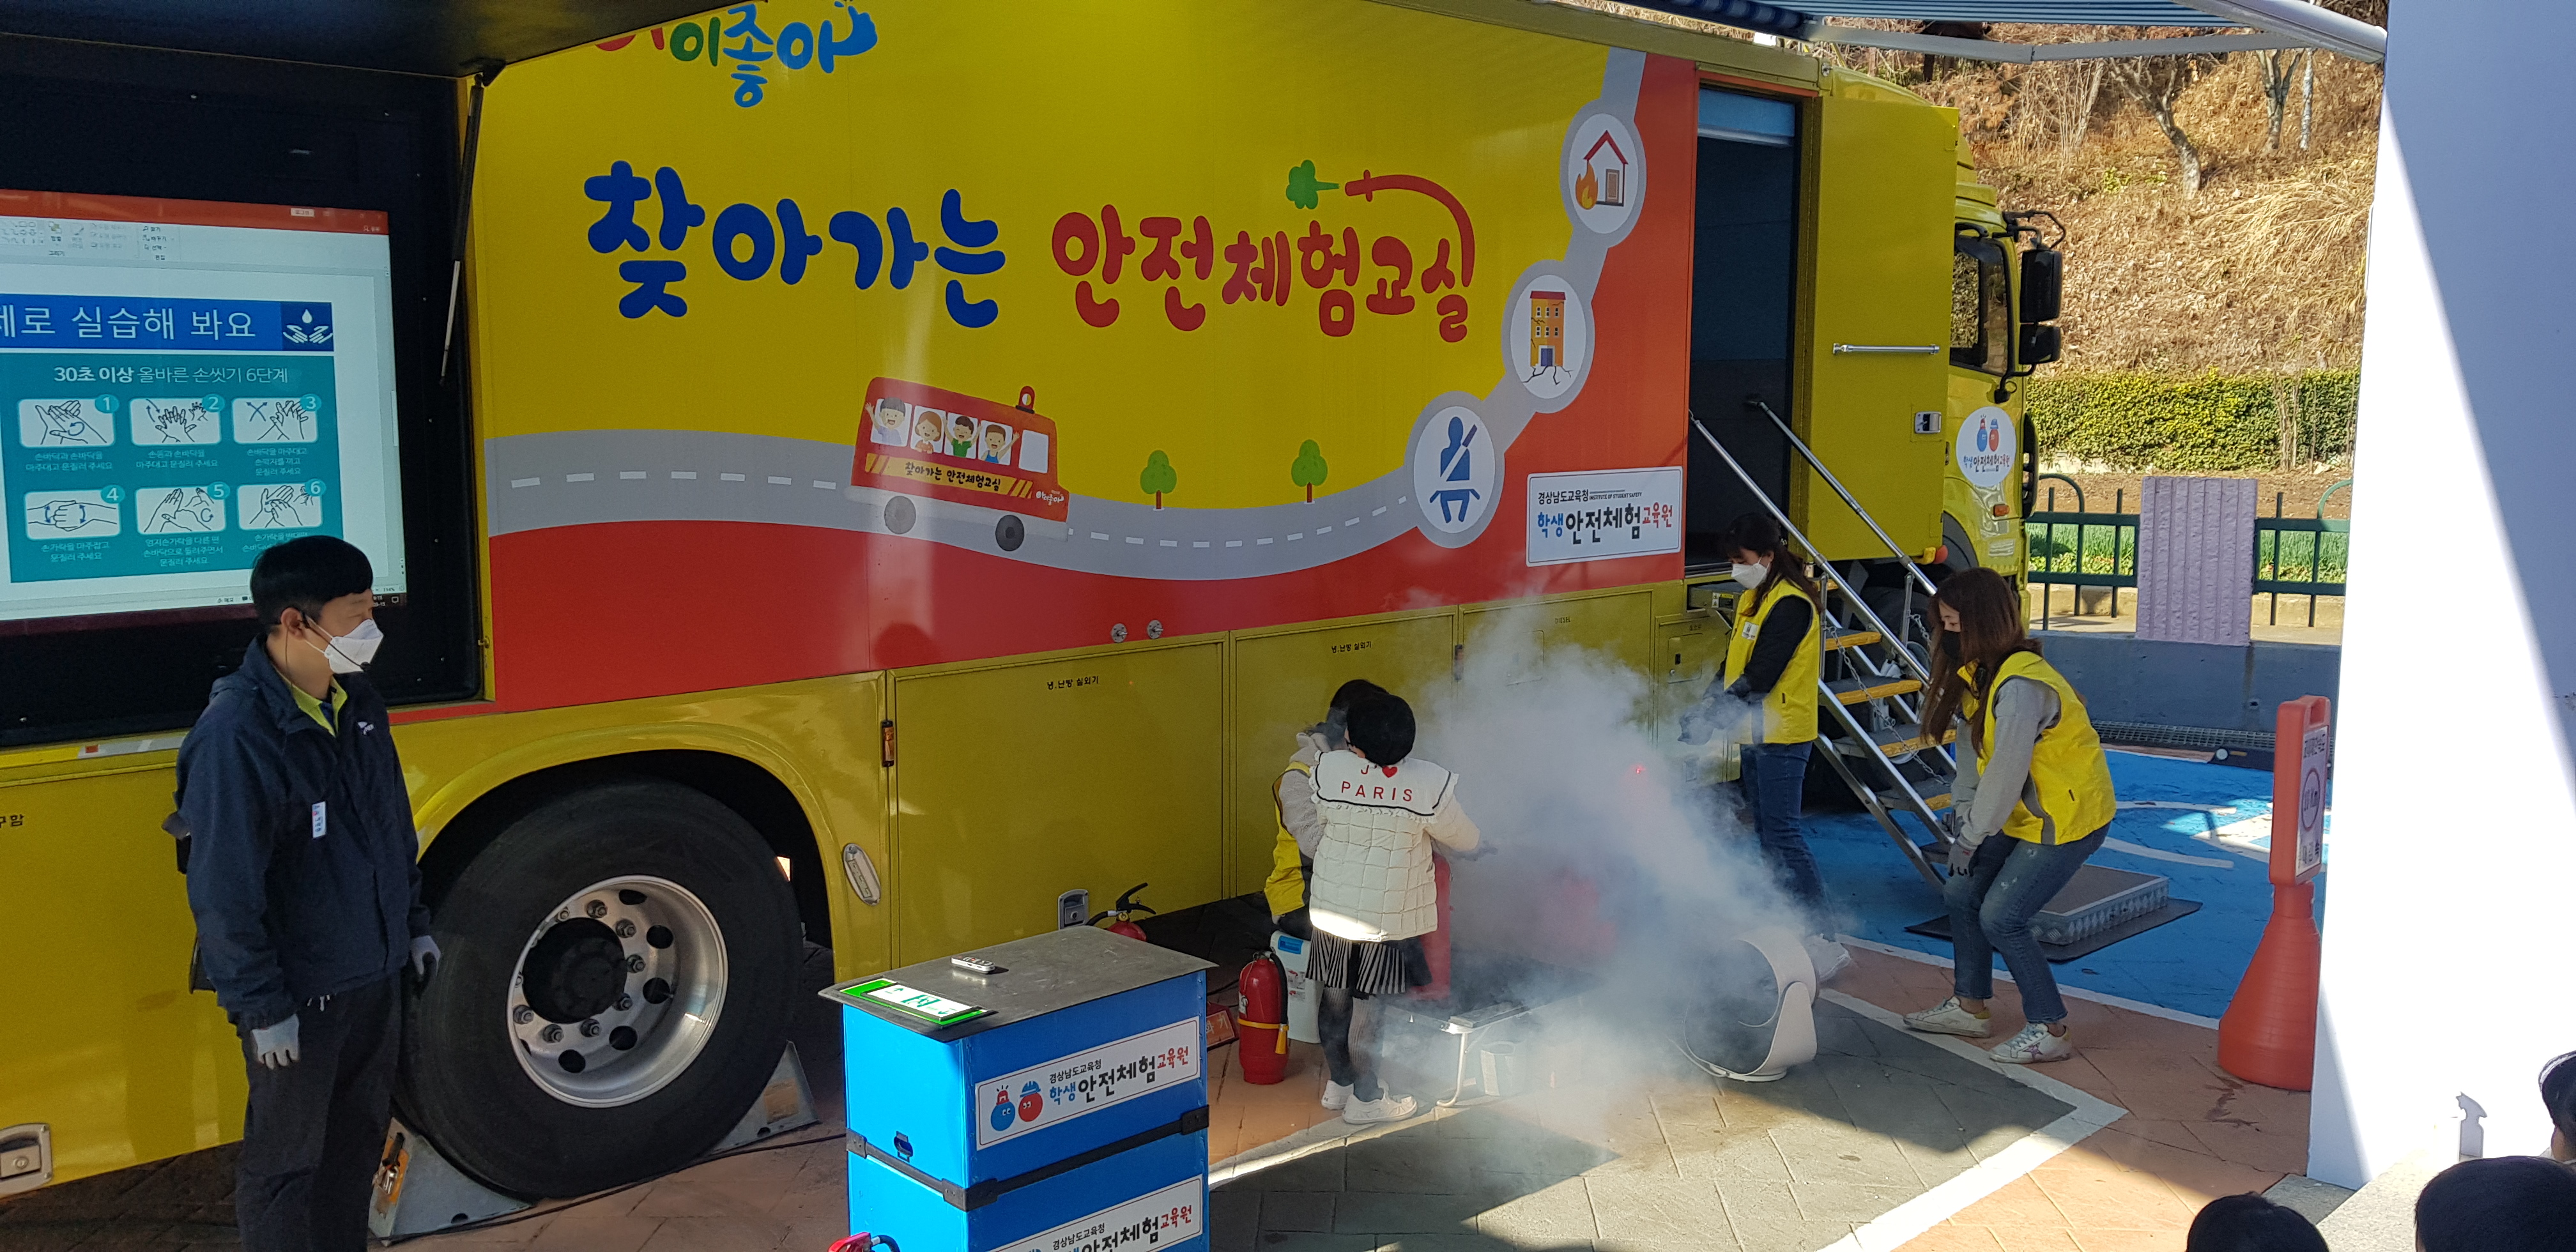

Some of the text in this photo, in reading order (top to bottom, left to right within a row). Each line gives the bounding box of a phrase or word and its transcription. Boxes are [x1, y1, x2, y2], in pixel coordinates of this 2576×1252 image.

[584, 160, 1475, 343] 찾아가는 안전체험교실
[72, 306, 174, 340] 실습해
[191, 310, 256, 340] 봐요
[54, 367, 288, 383] 30초 이상 올바른 손씻기 6단계
[102, 398, 111, 410] 1
[208, 397, 218, 409] 2
[305, 397, 316, 409] 3
[905, 461, 1000, 491] 찾아가는 안전체험교실
[106, 488, 119, 501] 4
[213, 484, 224, 497] 5
[310, 482, 321, 494] 6
[1538, 489, 1589, 505] 경상남도교육청
[1077, 675, 1099, 687] 실외기
[1341, 781, 1413, 802] PARIS
[1050, 1058, 1102, 1084] 경상남도교육청
[1052, 1223, 1105, 1250] 경상남도교육청
